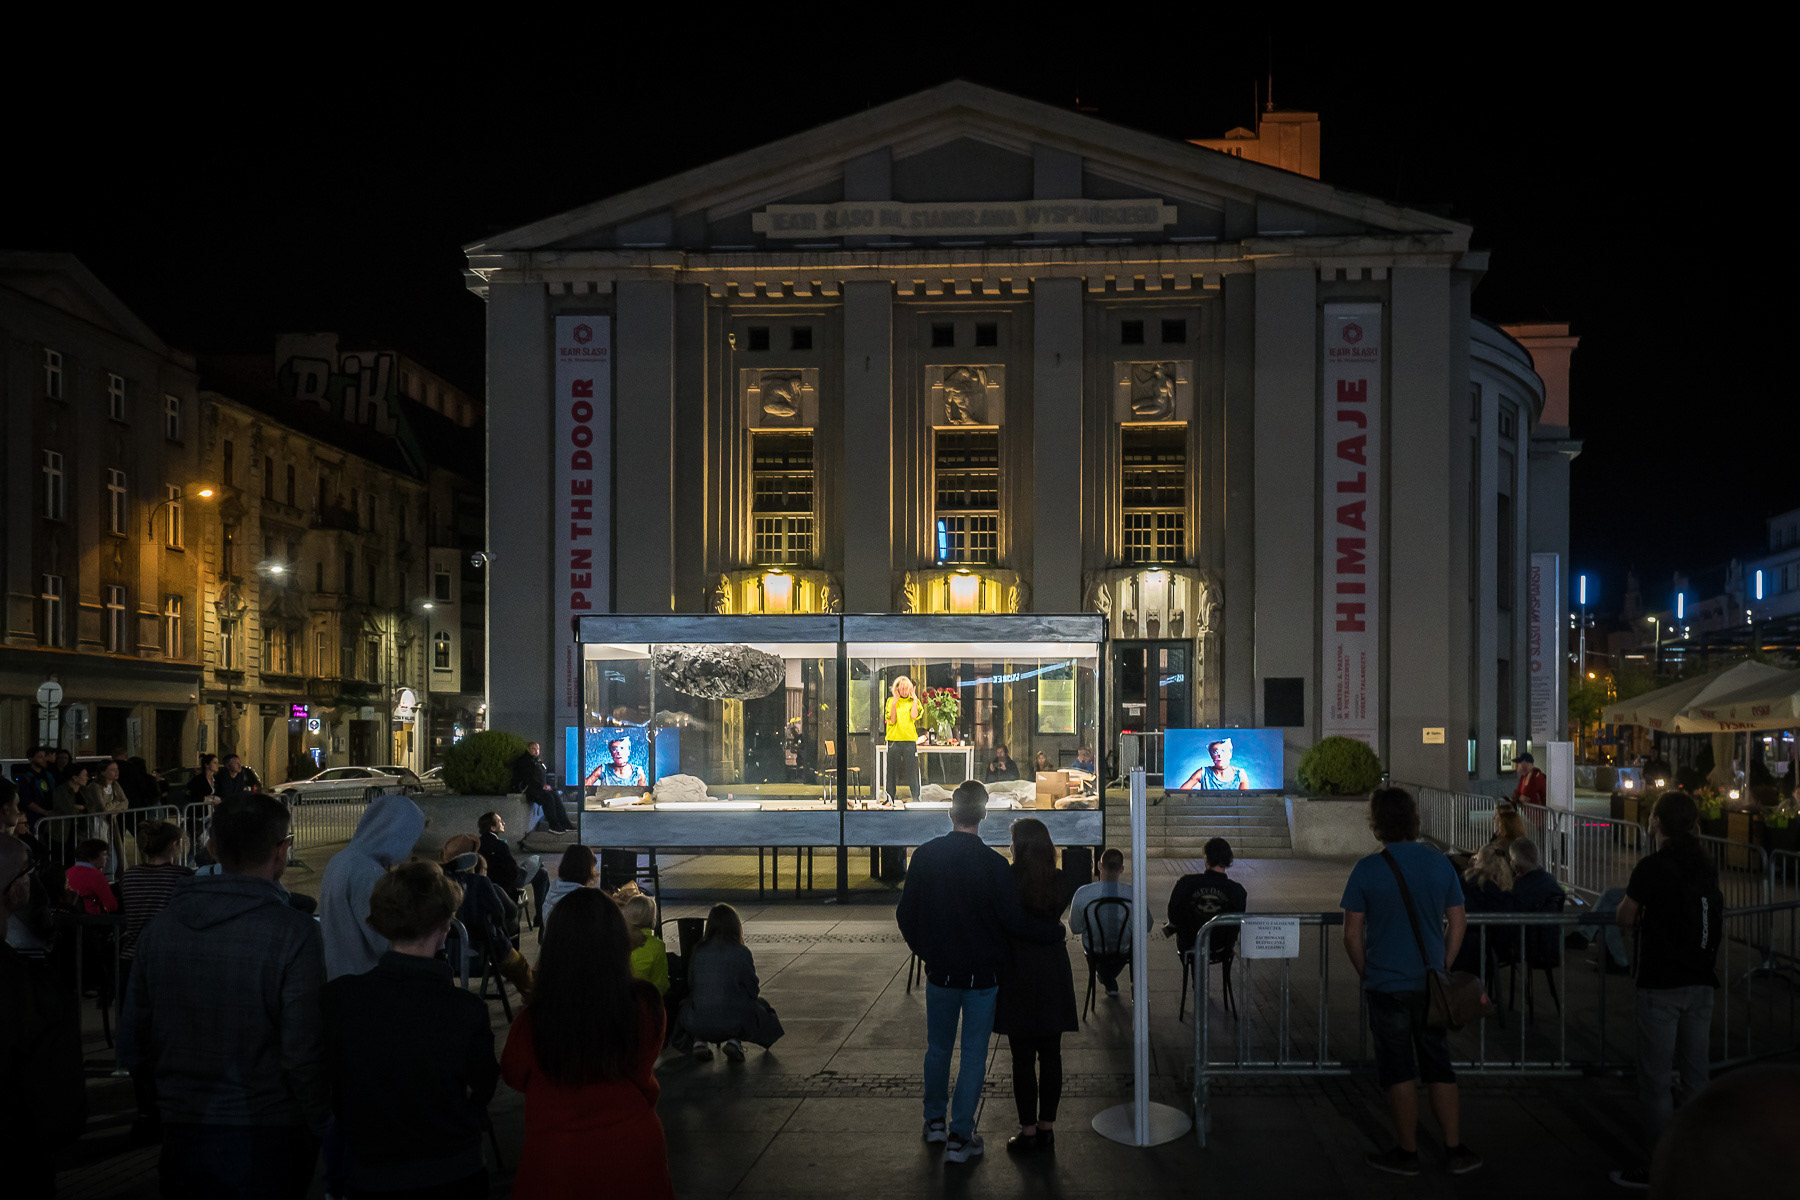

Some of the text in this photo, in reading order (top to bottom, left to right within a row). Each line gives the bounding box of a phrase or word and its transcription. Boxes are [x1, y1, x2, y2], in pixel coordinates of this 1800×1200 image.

[570, 378, 593, 471] DOOR
[571, 478, 593, 541] THE
[1336, 378, 1367, 632] HIMALAJE
[570, 548, 592, 631] PEN
